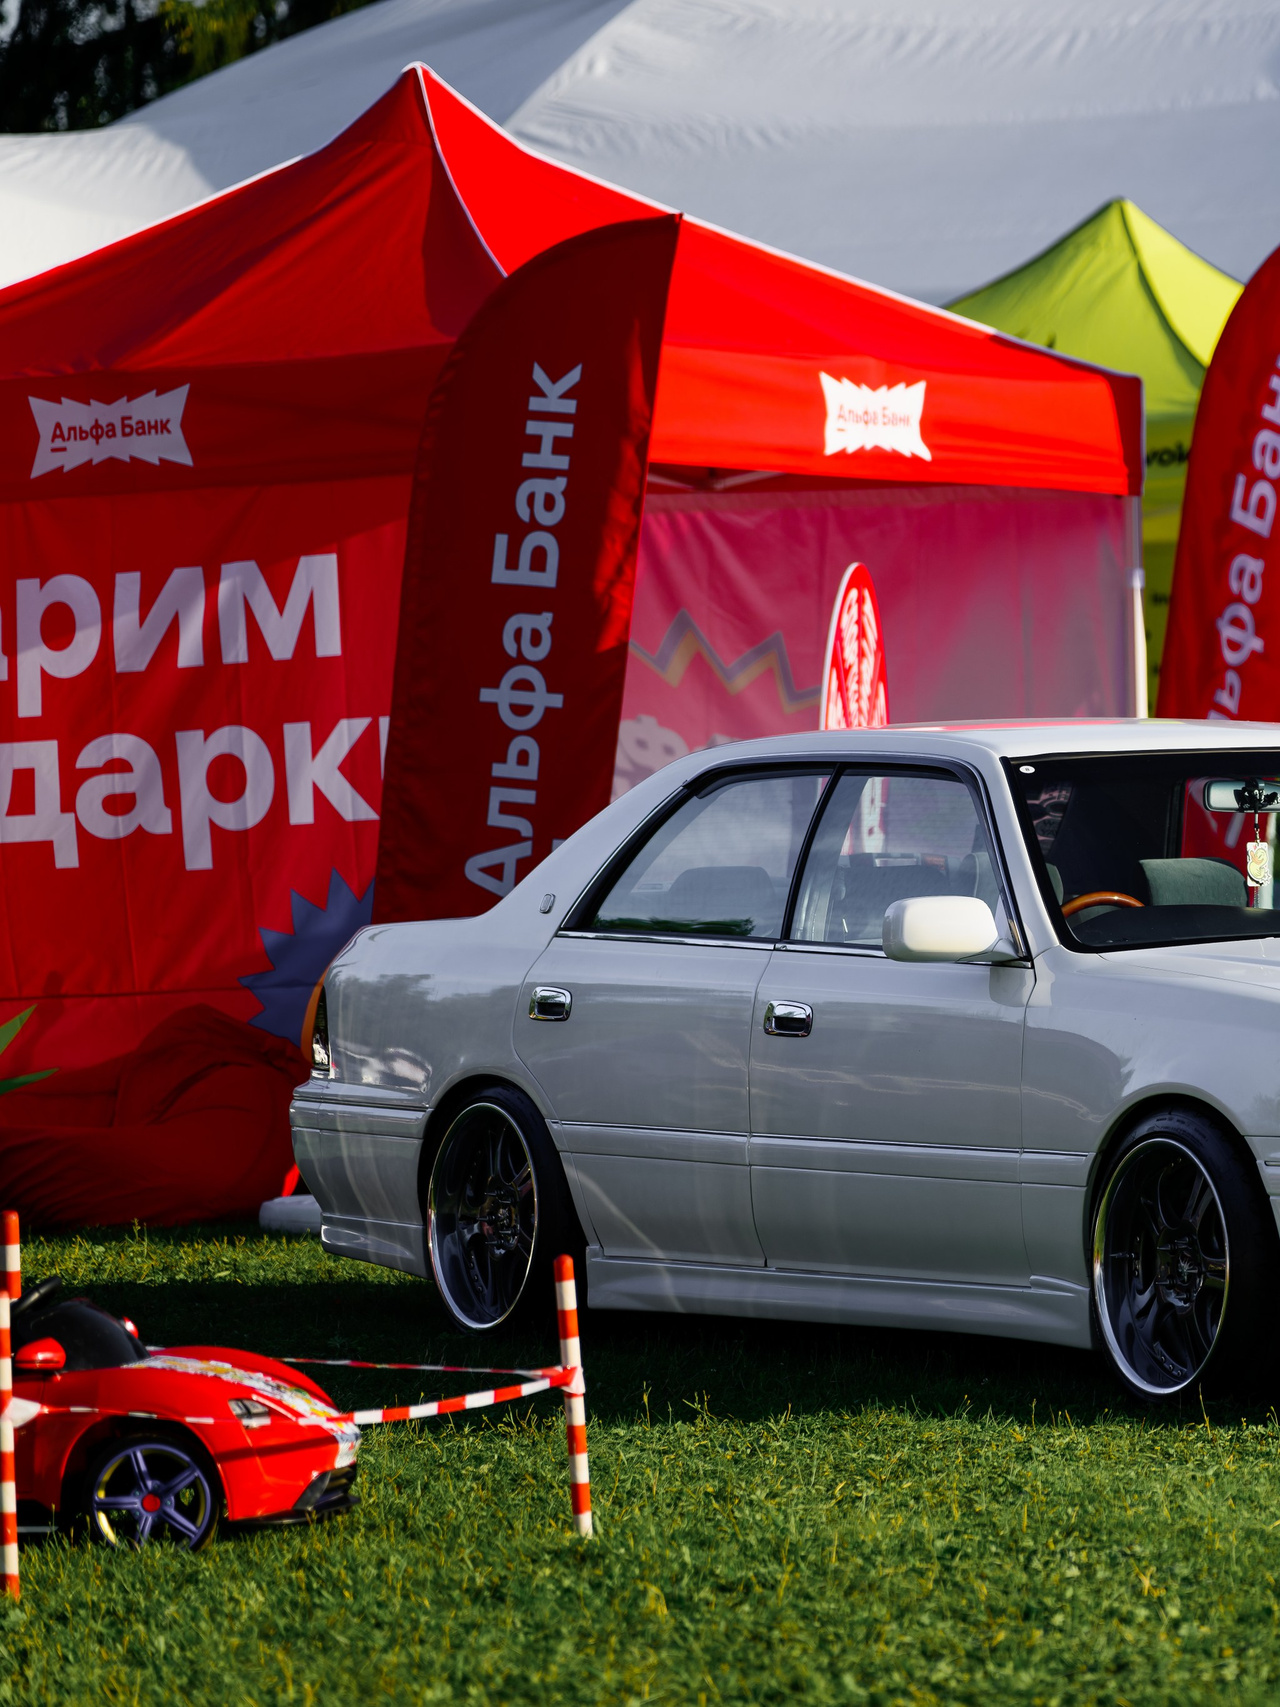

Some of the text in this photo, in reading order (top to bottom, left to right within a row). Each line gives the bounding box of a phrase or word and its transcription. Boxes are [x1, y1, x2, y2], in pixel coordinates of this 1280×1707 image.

[51, 415, 171, 449] Альфа Банк
[838, 403, 878, 430] Альфа
[0, 553, 341, 718] рим
[464, 361, 583, 898] Альфа Банк
[1207, 553, 1264, 720] ьфа
[0, 715, 390, 870] дарк
